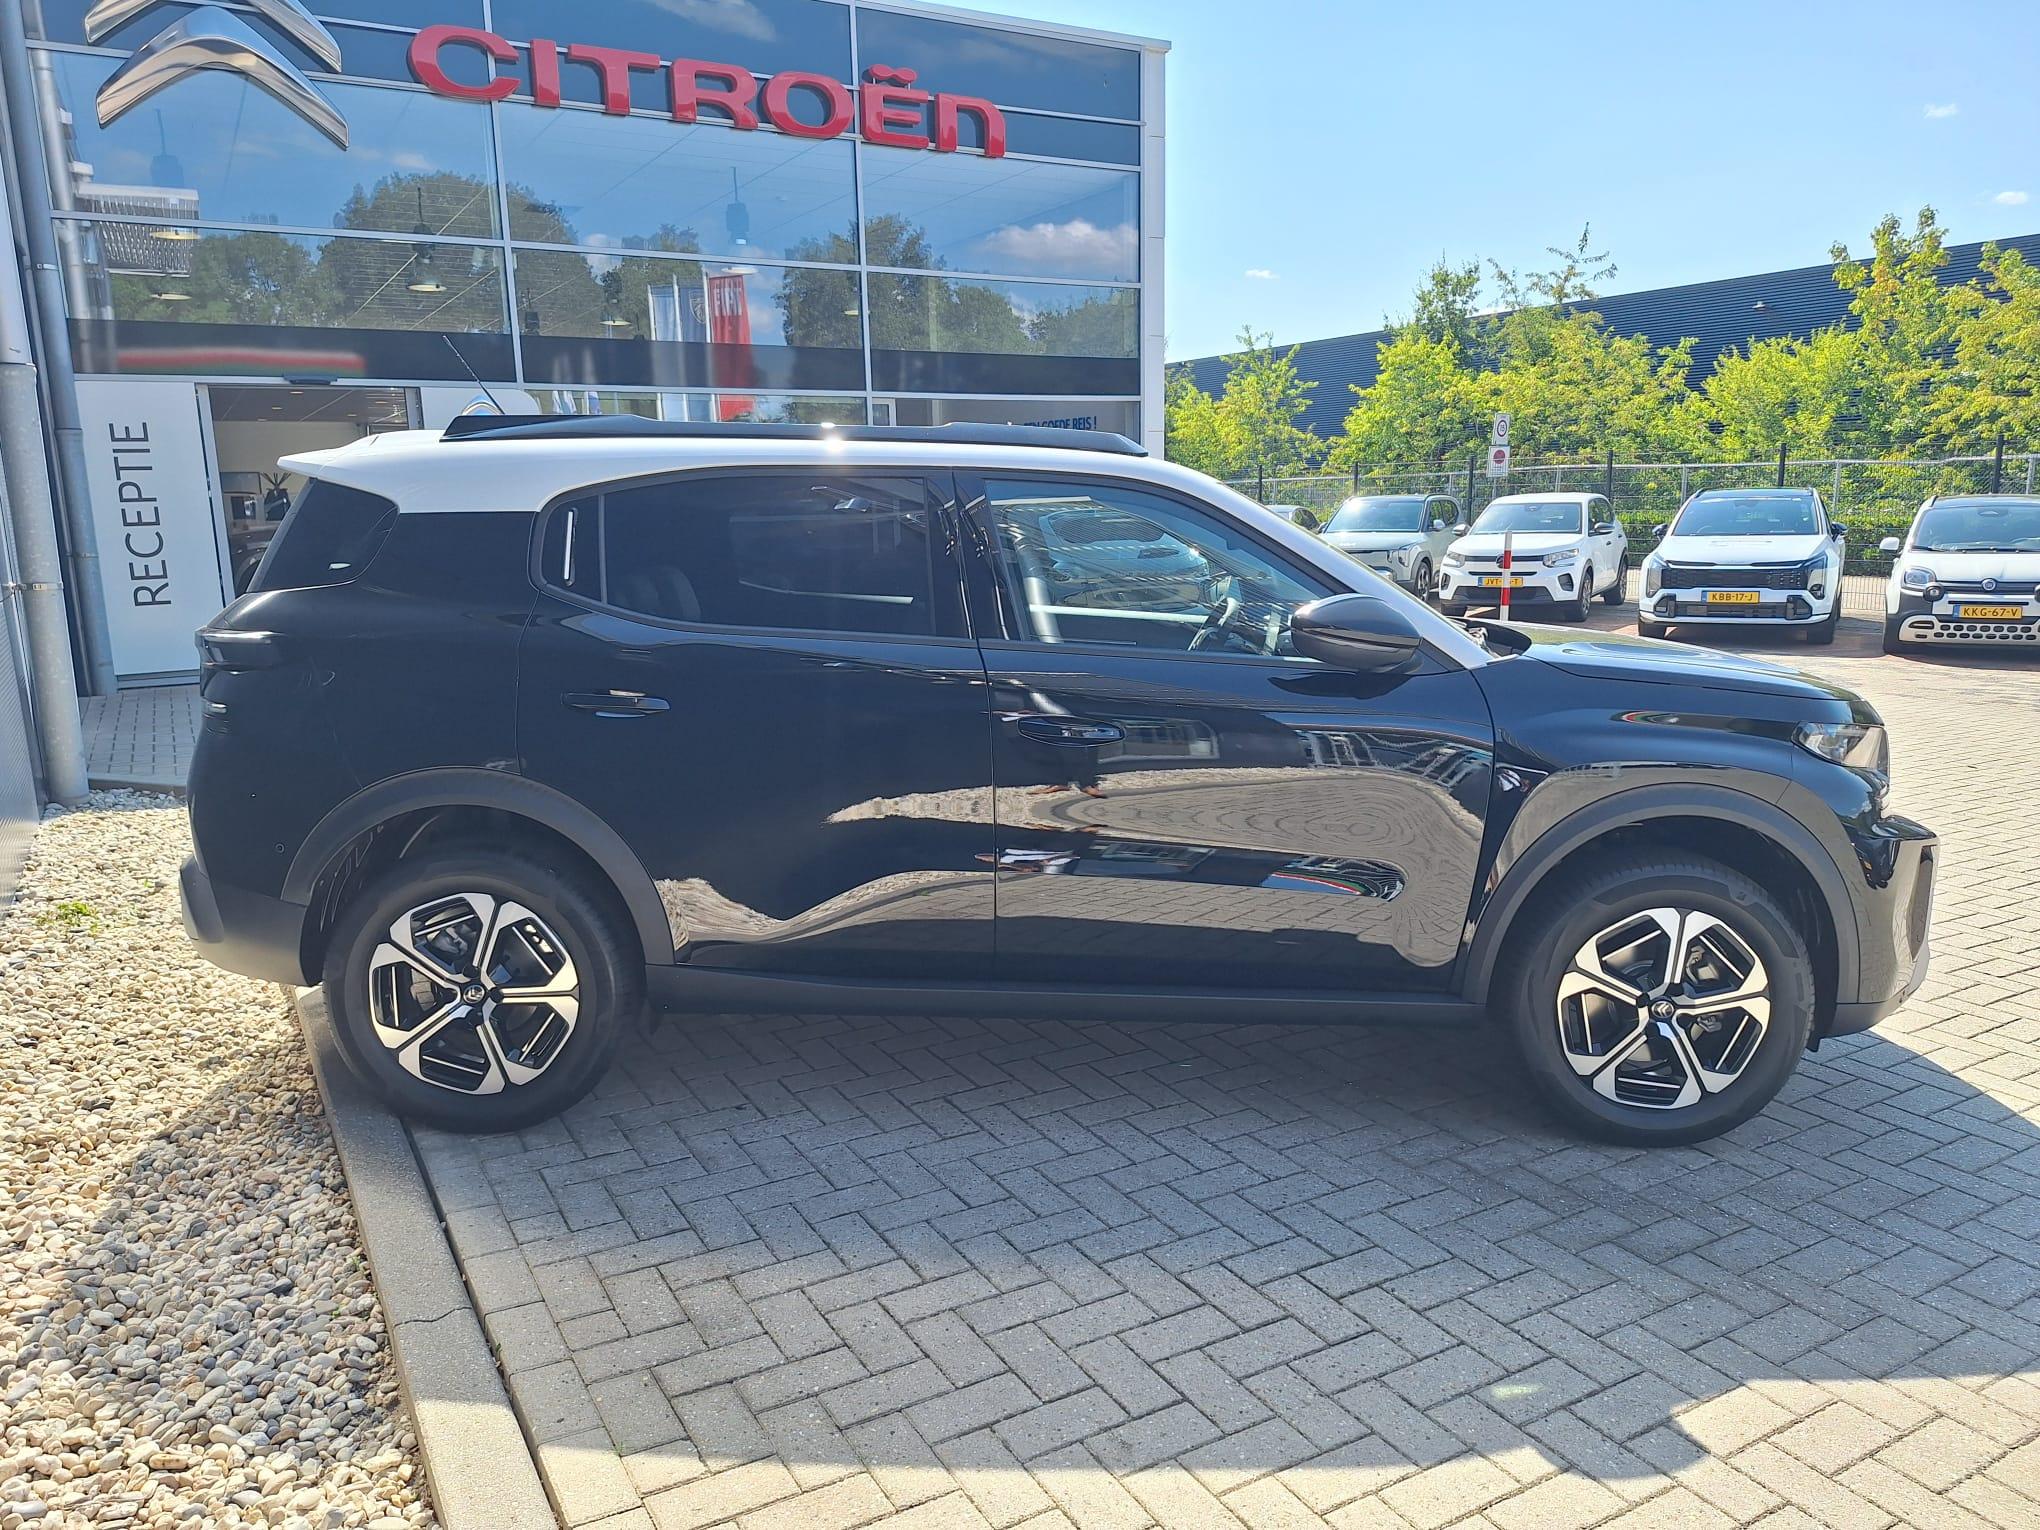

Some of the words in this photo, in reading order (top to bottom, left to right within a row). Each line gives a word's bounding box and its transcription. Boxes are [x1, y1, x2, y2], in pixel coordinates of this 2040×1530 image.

[1072, 416, 1092, 430] REIS
[108, 421, 172, 607] RECEPTIE
[1486, 578, 1519, 586] JVT--T
[1711, 592, 1753, 602] KBB-17-J
[1963, 607, 2018, 617] KKG-67-V
